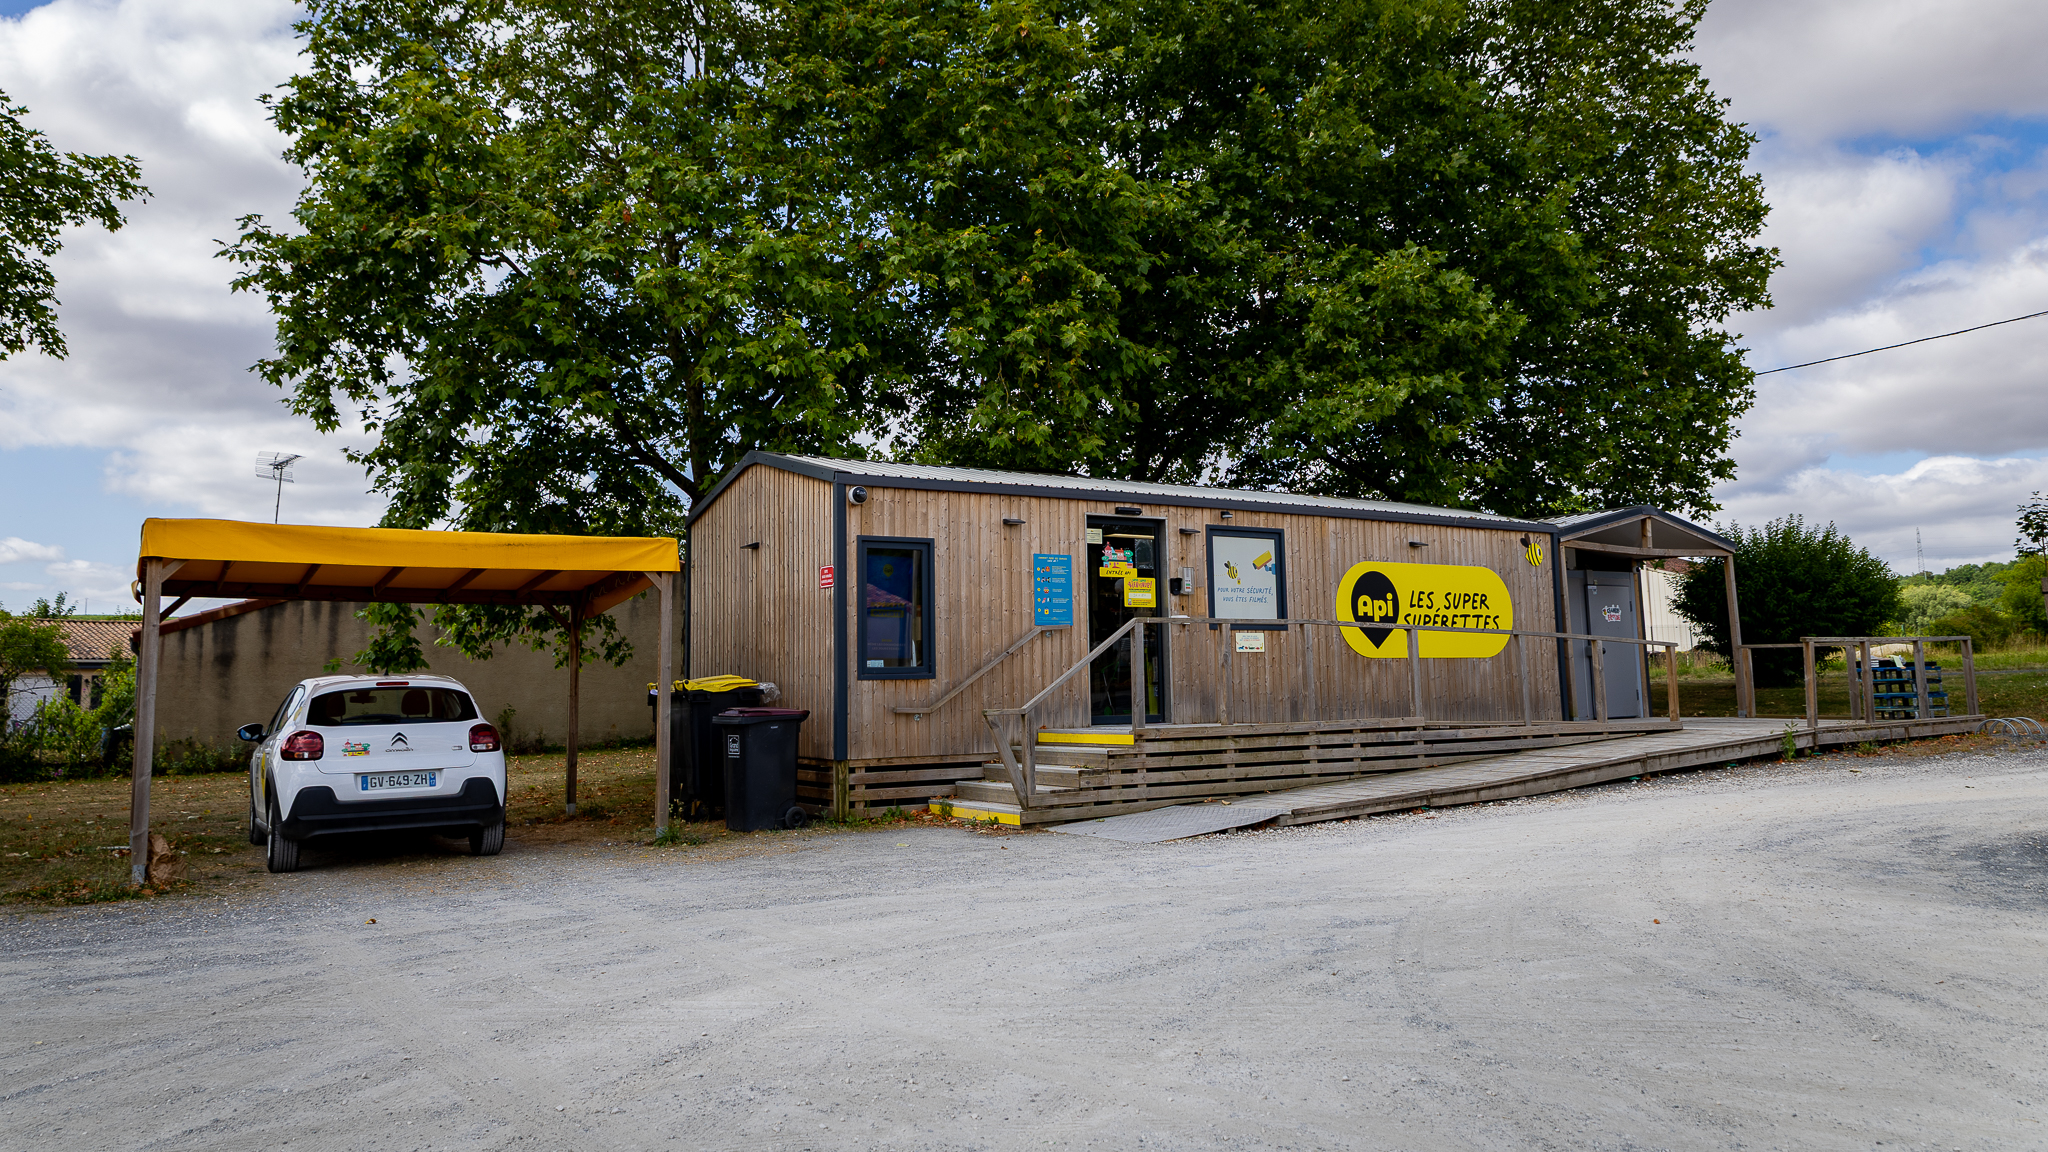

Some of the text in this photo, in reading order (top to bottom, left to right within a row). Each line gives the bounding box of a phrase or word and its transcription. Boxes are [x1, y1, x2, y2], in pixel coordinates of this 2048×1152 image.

[1235, 594, 1247, 603] ÊTES
[1357, 592, 1394, 622] Api
[1409, 590, 1490, 610] LES SUPER
[1403, 607, 1499, 630] SUPÉRETTES
[370, 773, 428, 788] GV-649-ZH
